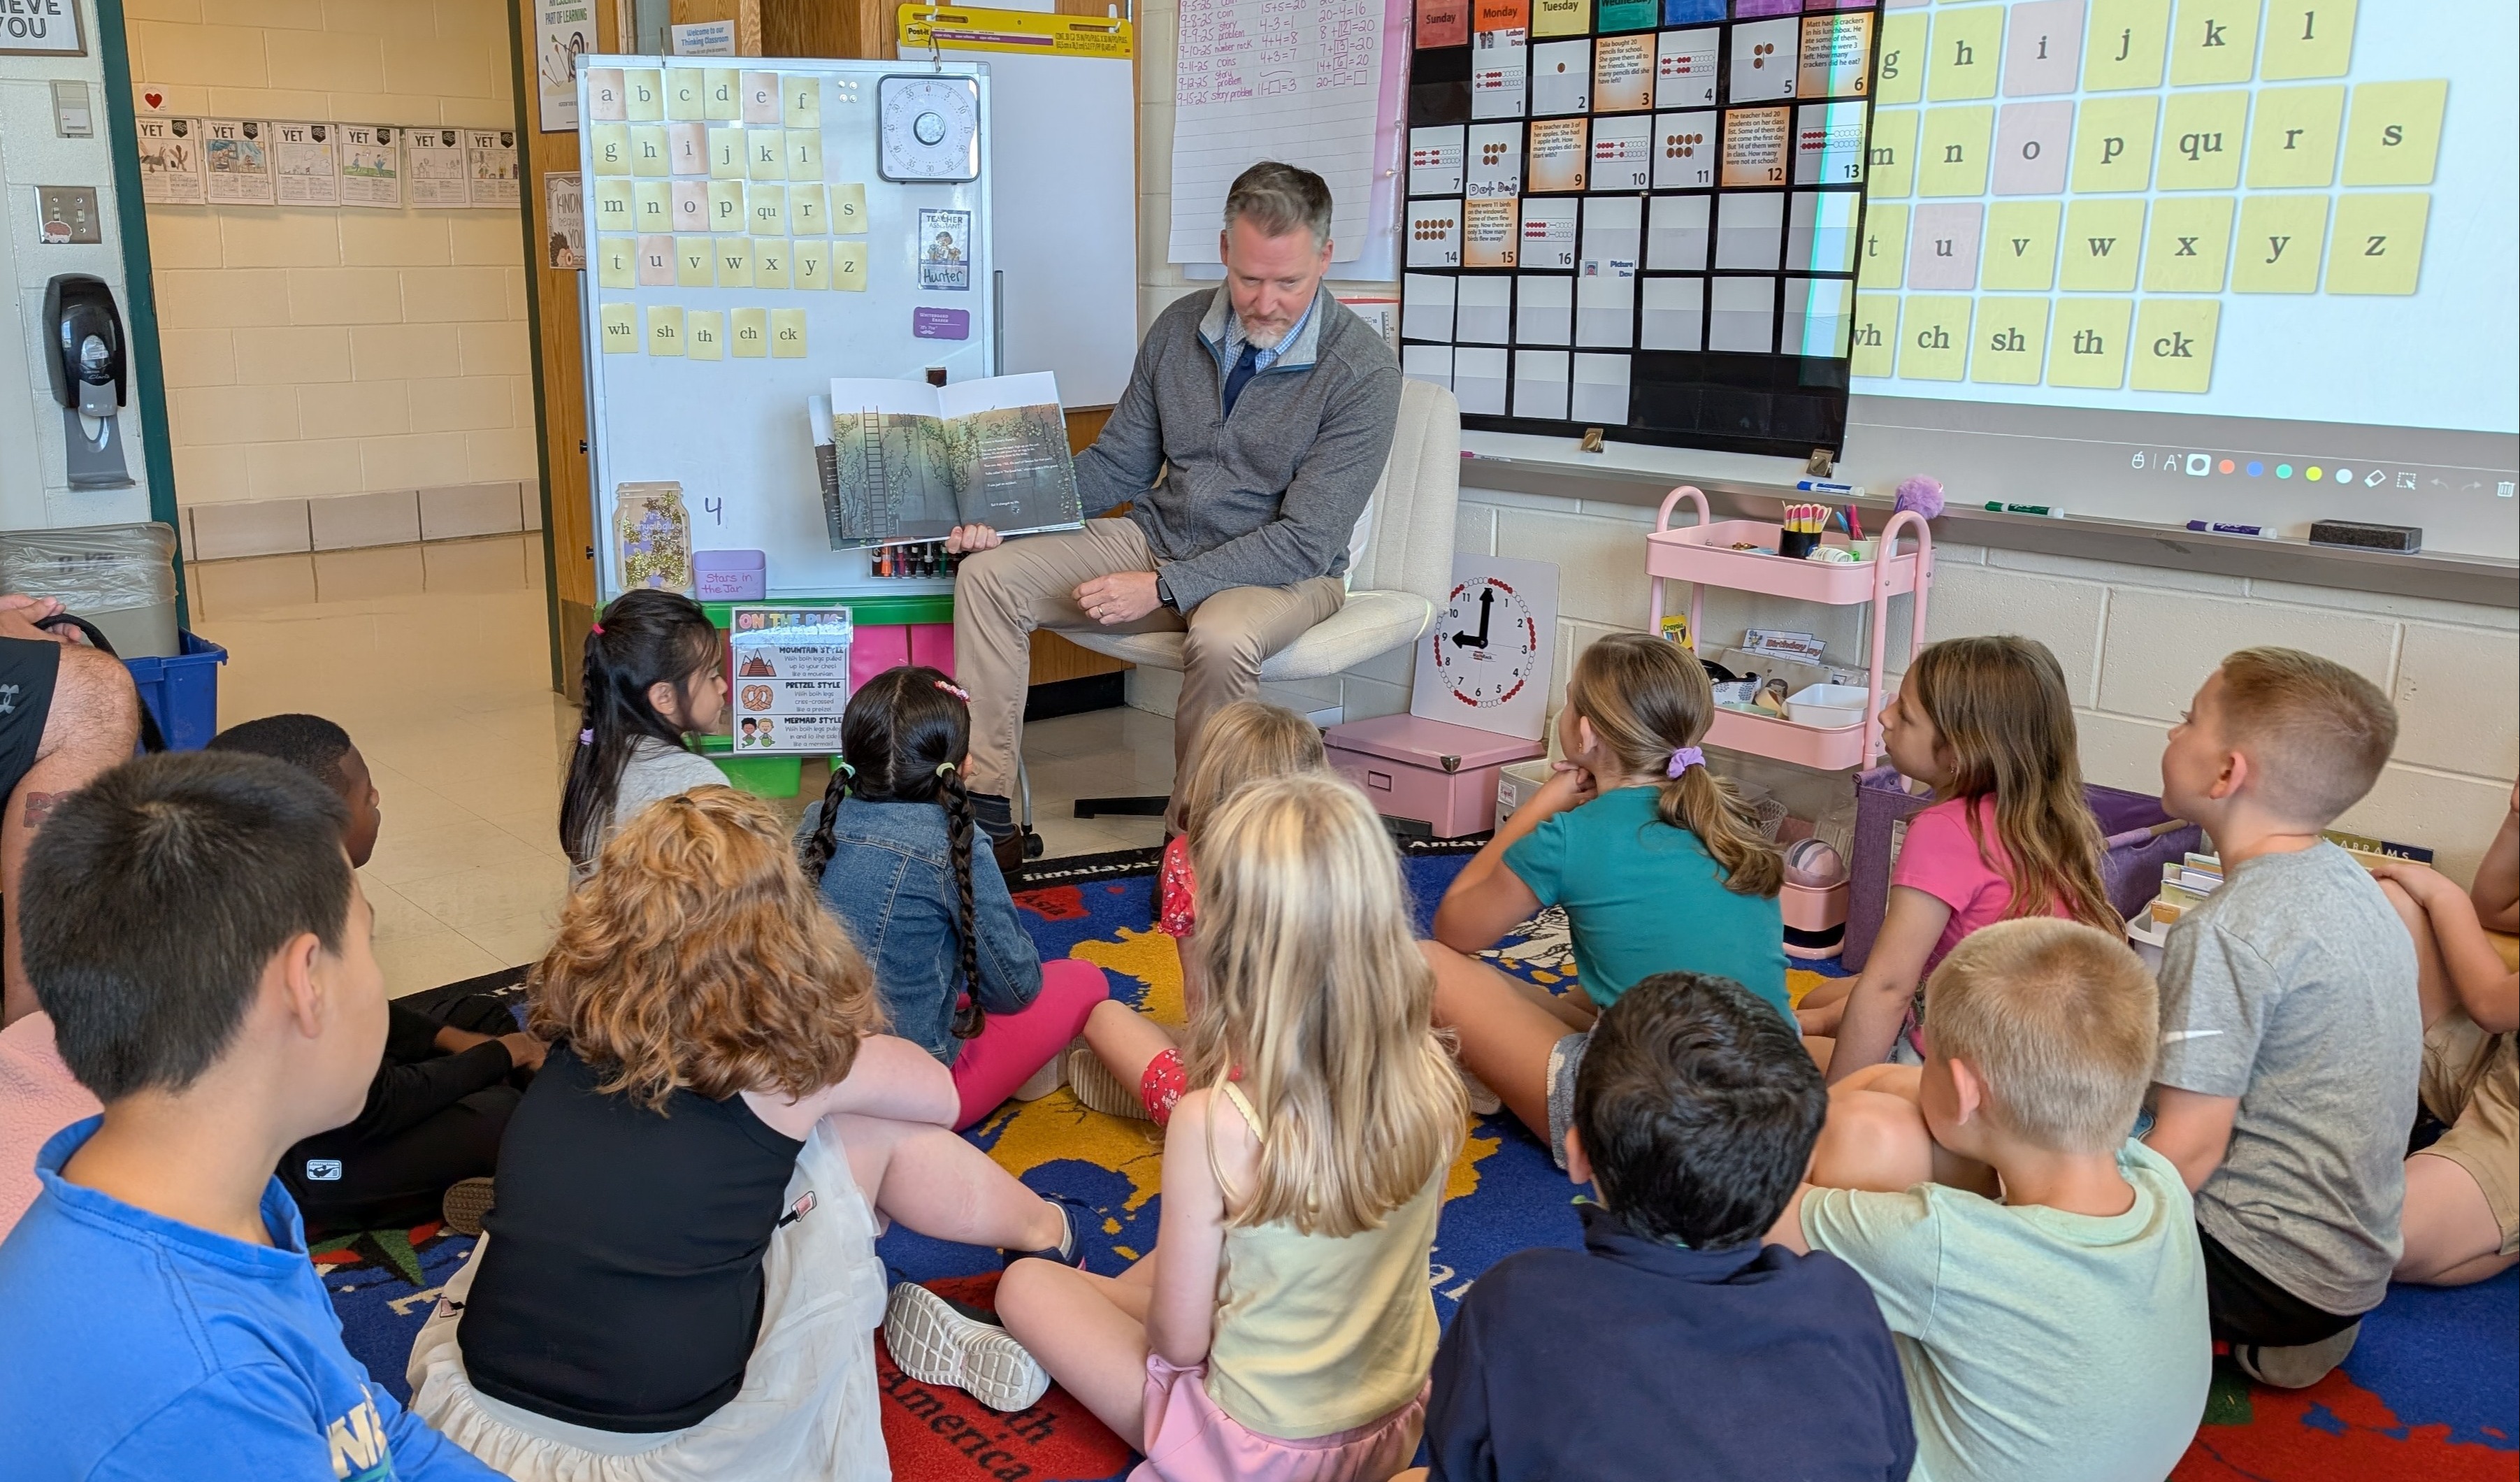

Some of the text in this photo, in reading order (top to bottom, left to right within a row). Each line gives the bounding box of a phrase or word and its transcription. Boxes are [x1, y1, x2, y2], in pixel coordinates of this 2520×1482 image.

[1181, 1, 1211, 12] 9-5-25
[1543, 0, 1578, 12] Tuesday
[563, 8, 587, 23] LEARNING
[1181, 9, 1233, 27] 9-8-25 coin
[1426, 13, 1456, 24] Sunday
[1483, 6, 1518, 19] Monday
[1219, 21, 1237, 31] story
[681, 36, 729, 47] Thinking Classroom
[1181, 27, 1244, 45] 9-9-25 problem
[1180, 40, 1253, 58] 9-10-25 number rack
[1882, 11, 2314, 79] g h i j k l
[1179, 57, 1236, 73] 9-11-25 coins
[1215, 71, 1233, 80] story
[1179, 75, 1241, 94] 9-12-25 problem
[1784, 80, 1792, 93] 5
[1855, 77, 1864, 91] 6
[602, 85, 806, 109] a b c d e f
[1177, 87, 1253, 106] 9-15-25 story problem
[1642, 93, 1649, 105] 3
[1705, 89, 1713, 101] 4
[1516, 101, 1520, 113] 1
[1578, 96, 1585, 108] 2
[141, 125, 164, 137] YET
[213, 127, 235, 138] YET
[282, 129, 303, 142] YET
[350, 131, 369, 144] YET
[415, 136, 435, 147] YET
[475, 136, 494, 148] YET
[1869, 125, 2402, 165] m n o p qu r s
[605, 141, 807, 164] g h i j k l
[1697, 171, 1708, 182] 11
[1768, 168, 1782, 180] 12
[1845, 164, 1859, 178] 13
[1454, 178, 1460, 189] 7
[1575, 174, 1582, 186] 9
[1632, 173, 1646, 185] 10
[1469, 181, 1495, 196] Dot
[604, 201, 854, 220] m n o p qu r s
[1869, 235, 2386, 264] t u v w x y z
[1446, 252, 1457, 262] 14
[1502, 252, 1513, 263] 15
[1559, 253, 1571, 264] 16
[614, 254, 854, 275] t u v w x y z
[924, 268, 962, 283] Hunter
[608, 323, 797, 342] wh sh th ch ck
[1918, 325, 2194, 357] ch sh th ck
[705, 497, 721, 526] 4
[707, 573, 752, 583] Stars in
[702, 584, 743, 593] the Jar
[1462, 593, 1470, 602] 11
[1505, 598, 1508, 607] 1
[1450, 609, 1458, 618] 10
[739, 614, 800, 629] ON THE
[1518, 619, 1522, 628] 2
[1442, 633, 1448, 641] 9
[1522, 645, 1527, 654] 3
[1766, 640, 1806, 652] Birthday
[1445, 657, 1450, 666] 8
[1513, 668, 1518, 677] 4
[1458, 677, 1464, 685] 7
[1476, 688, 1481, 696] 6
[1496, 684, 1501, 693] 5
